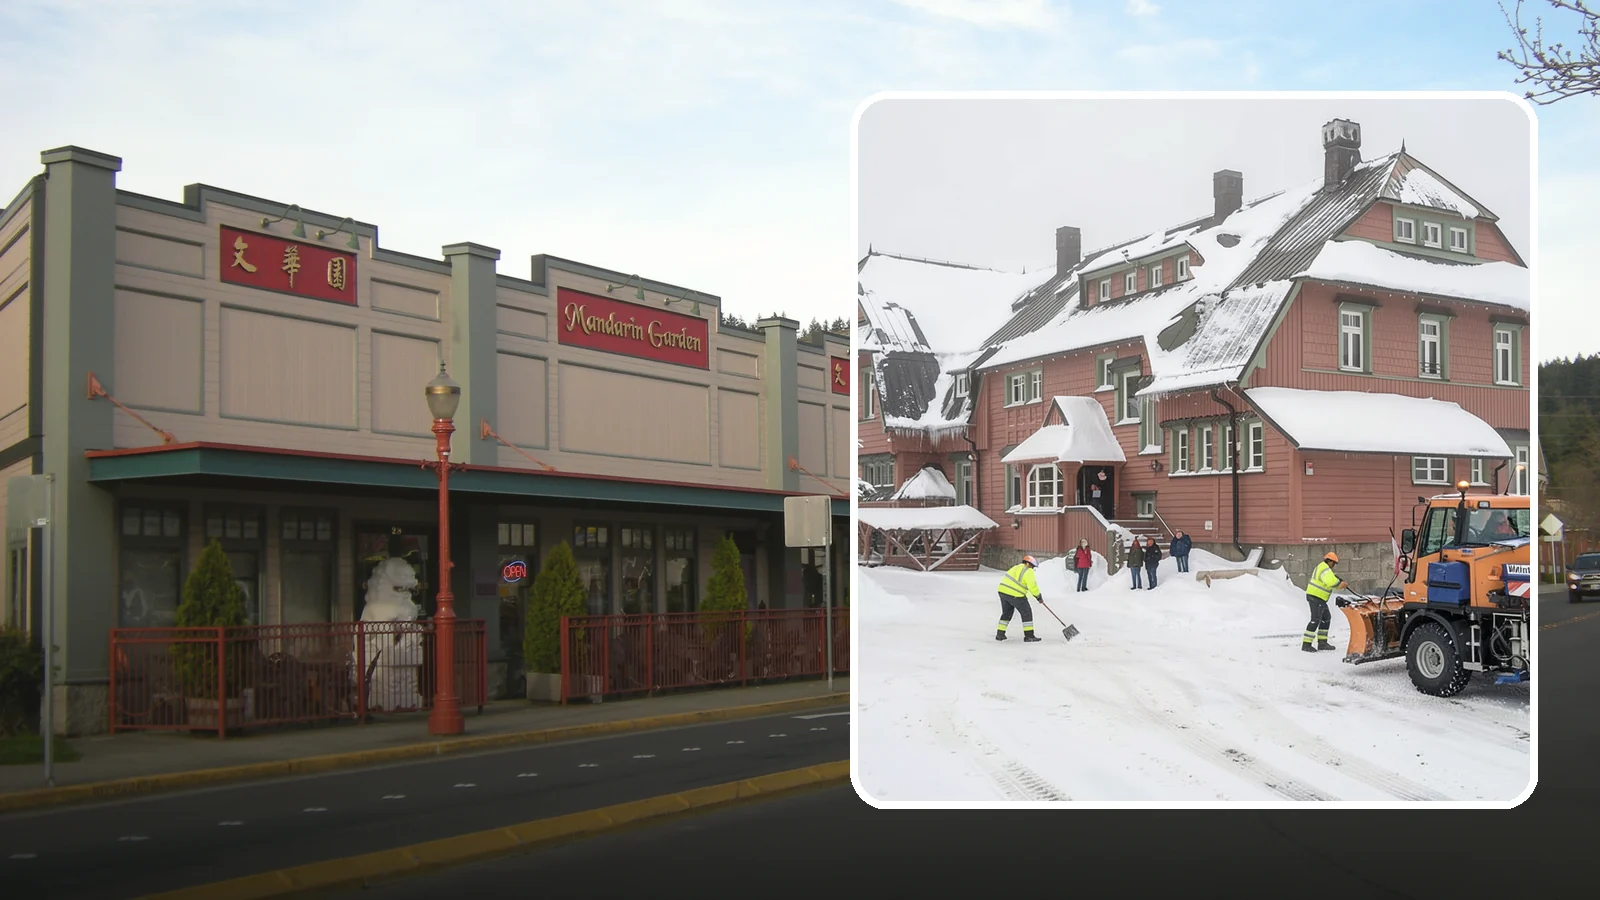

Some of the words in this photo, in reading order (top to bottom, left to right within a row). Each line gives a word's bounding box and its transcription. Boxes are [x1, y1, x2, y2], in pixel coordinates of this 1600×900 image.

[231, 236, 346, 291] 文華園
[564, 302, 644, 341] Mandarin
[647, 320, 701, 352] Garden
[503, 565, 527, 578] OPEN
